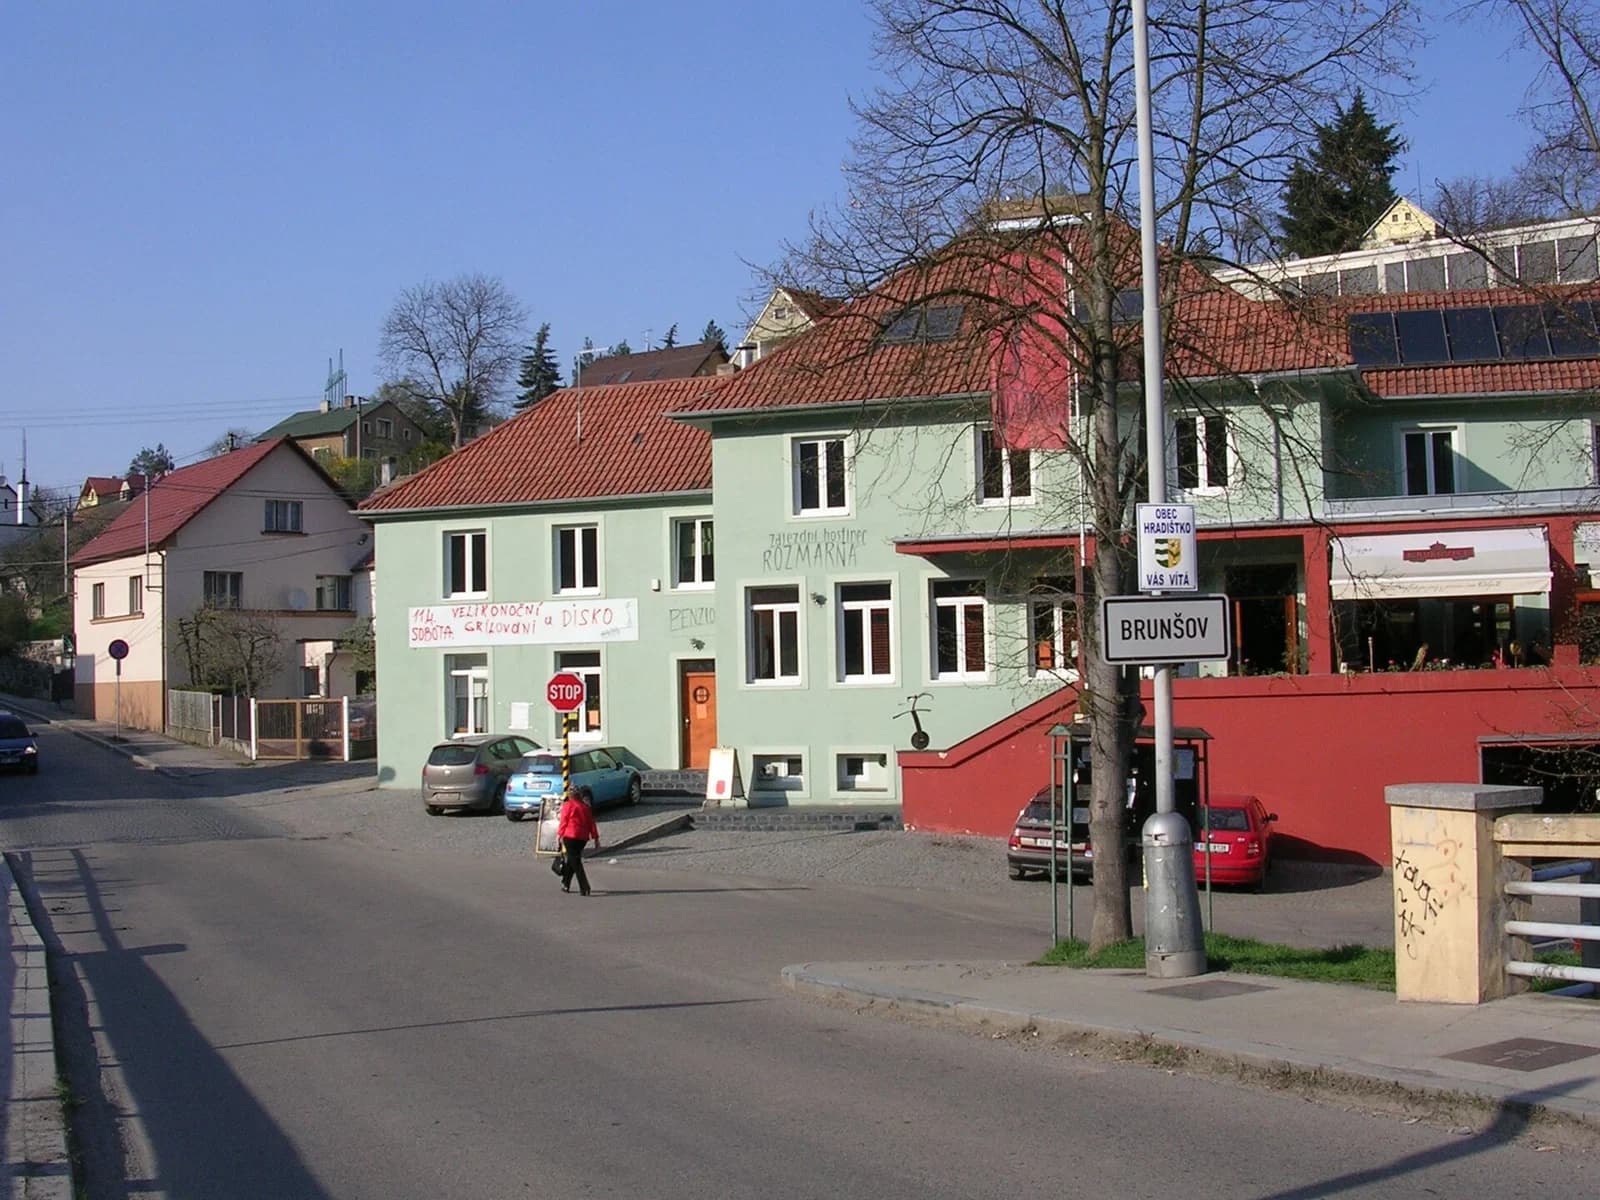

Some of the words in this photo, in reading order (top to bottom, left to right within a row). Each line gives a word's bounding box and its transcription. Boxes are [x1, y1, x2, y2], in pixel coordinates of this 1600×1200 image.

[1155, 508, 1178, 520] OBEC
[1143, 520, 1192, 534] HRADIŠTKO
[1146, 571, 1165, 586] VÁS
[1169, 571, 1190, 586] VÍTÁ
[1121, 612, 1209, 641] BRUNŠOV
[550, 684, 581, 700] STOP
